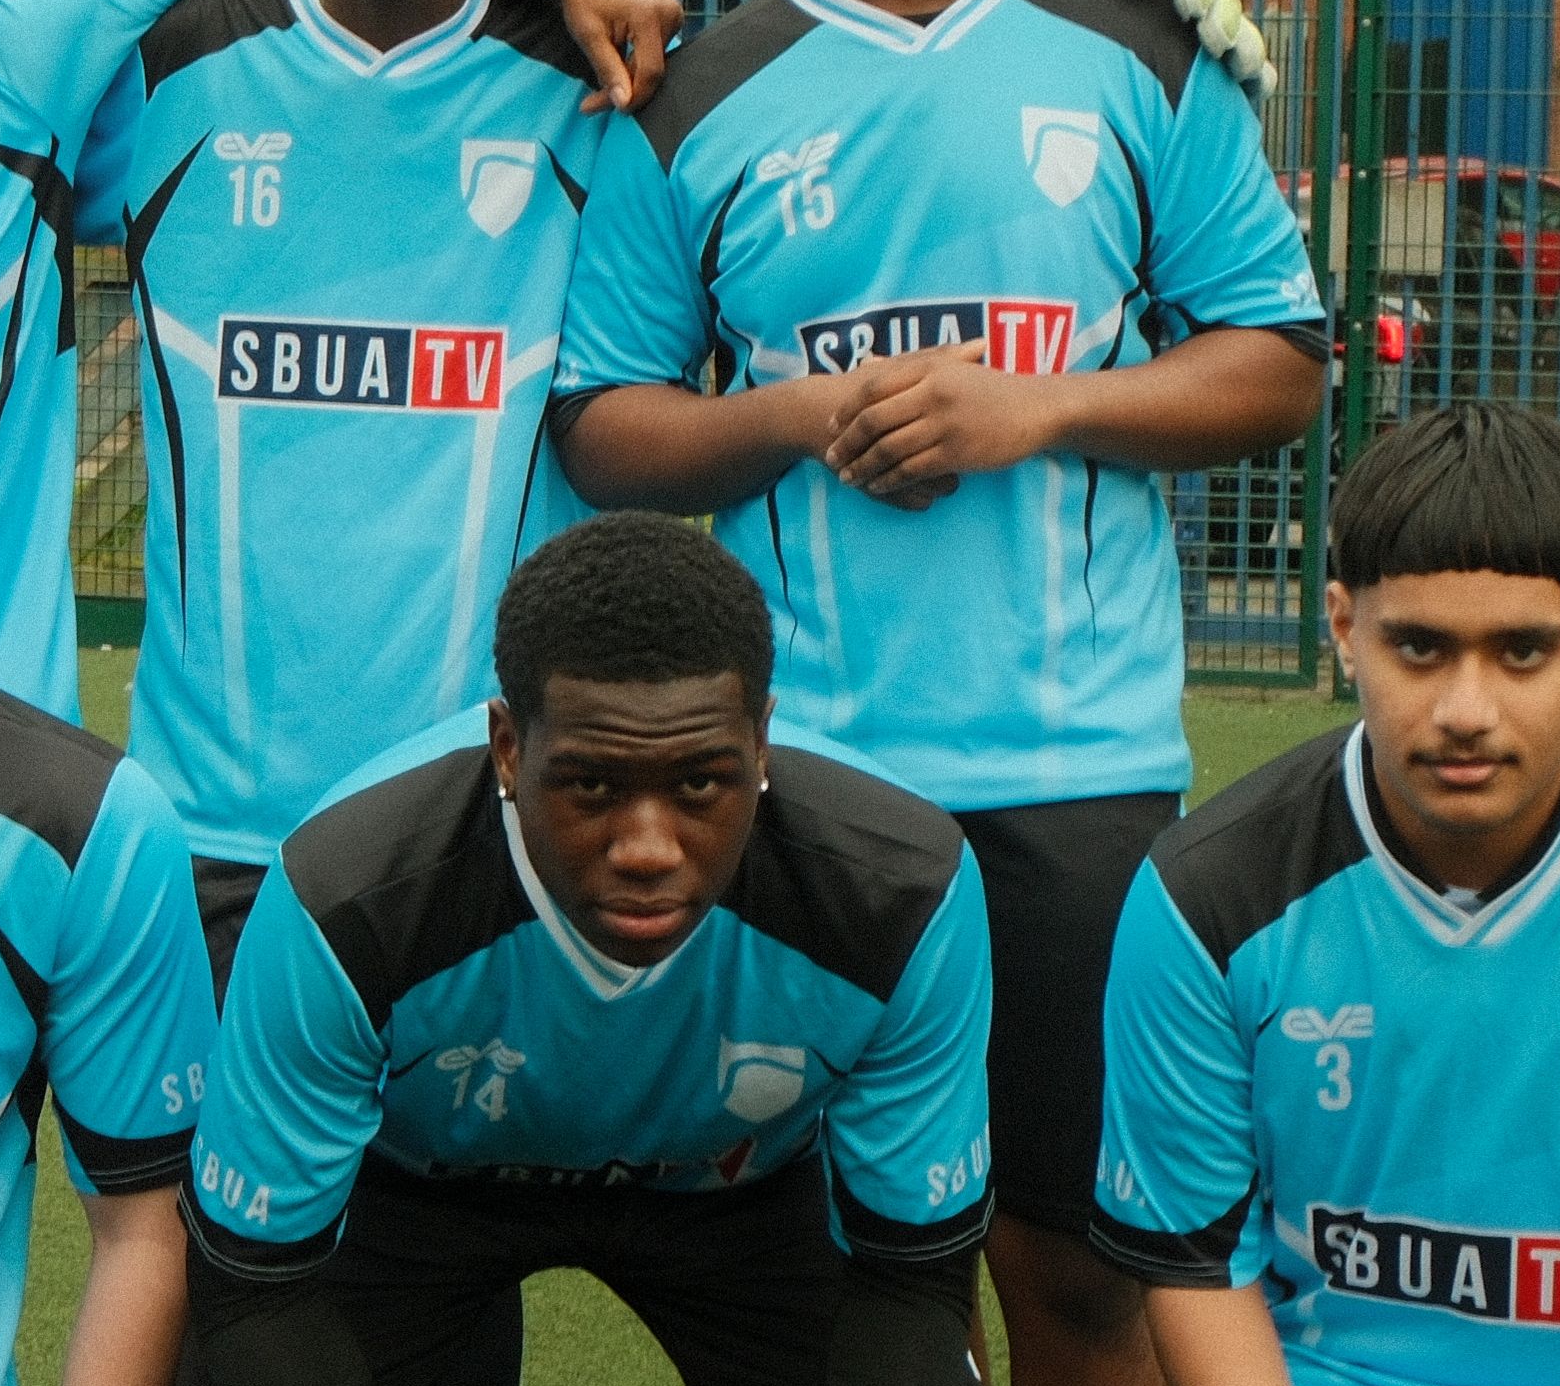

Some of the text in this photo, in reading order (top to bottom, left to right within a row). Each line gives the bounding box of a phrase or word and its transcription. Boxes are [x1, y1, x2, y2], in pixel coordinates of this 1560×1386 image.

[229, 165, 281, 227] 16
[779, 165, 835, 236] 15
[230, 330, 390, 399] SBUA
[425, 338, 496, 402] TV
[997, 312, 1067, 375] TV
[161, 1062, 206, 1115] SB
[451, 1067, 509, 1122] 14
[1315, 1041, 1353, 1111] 3
